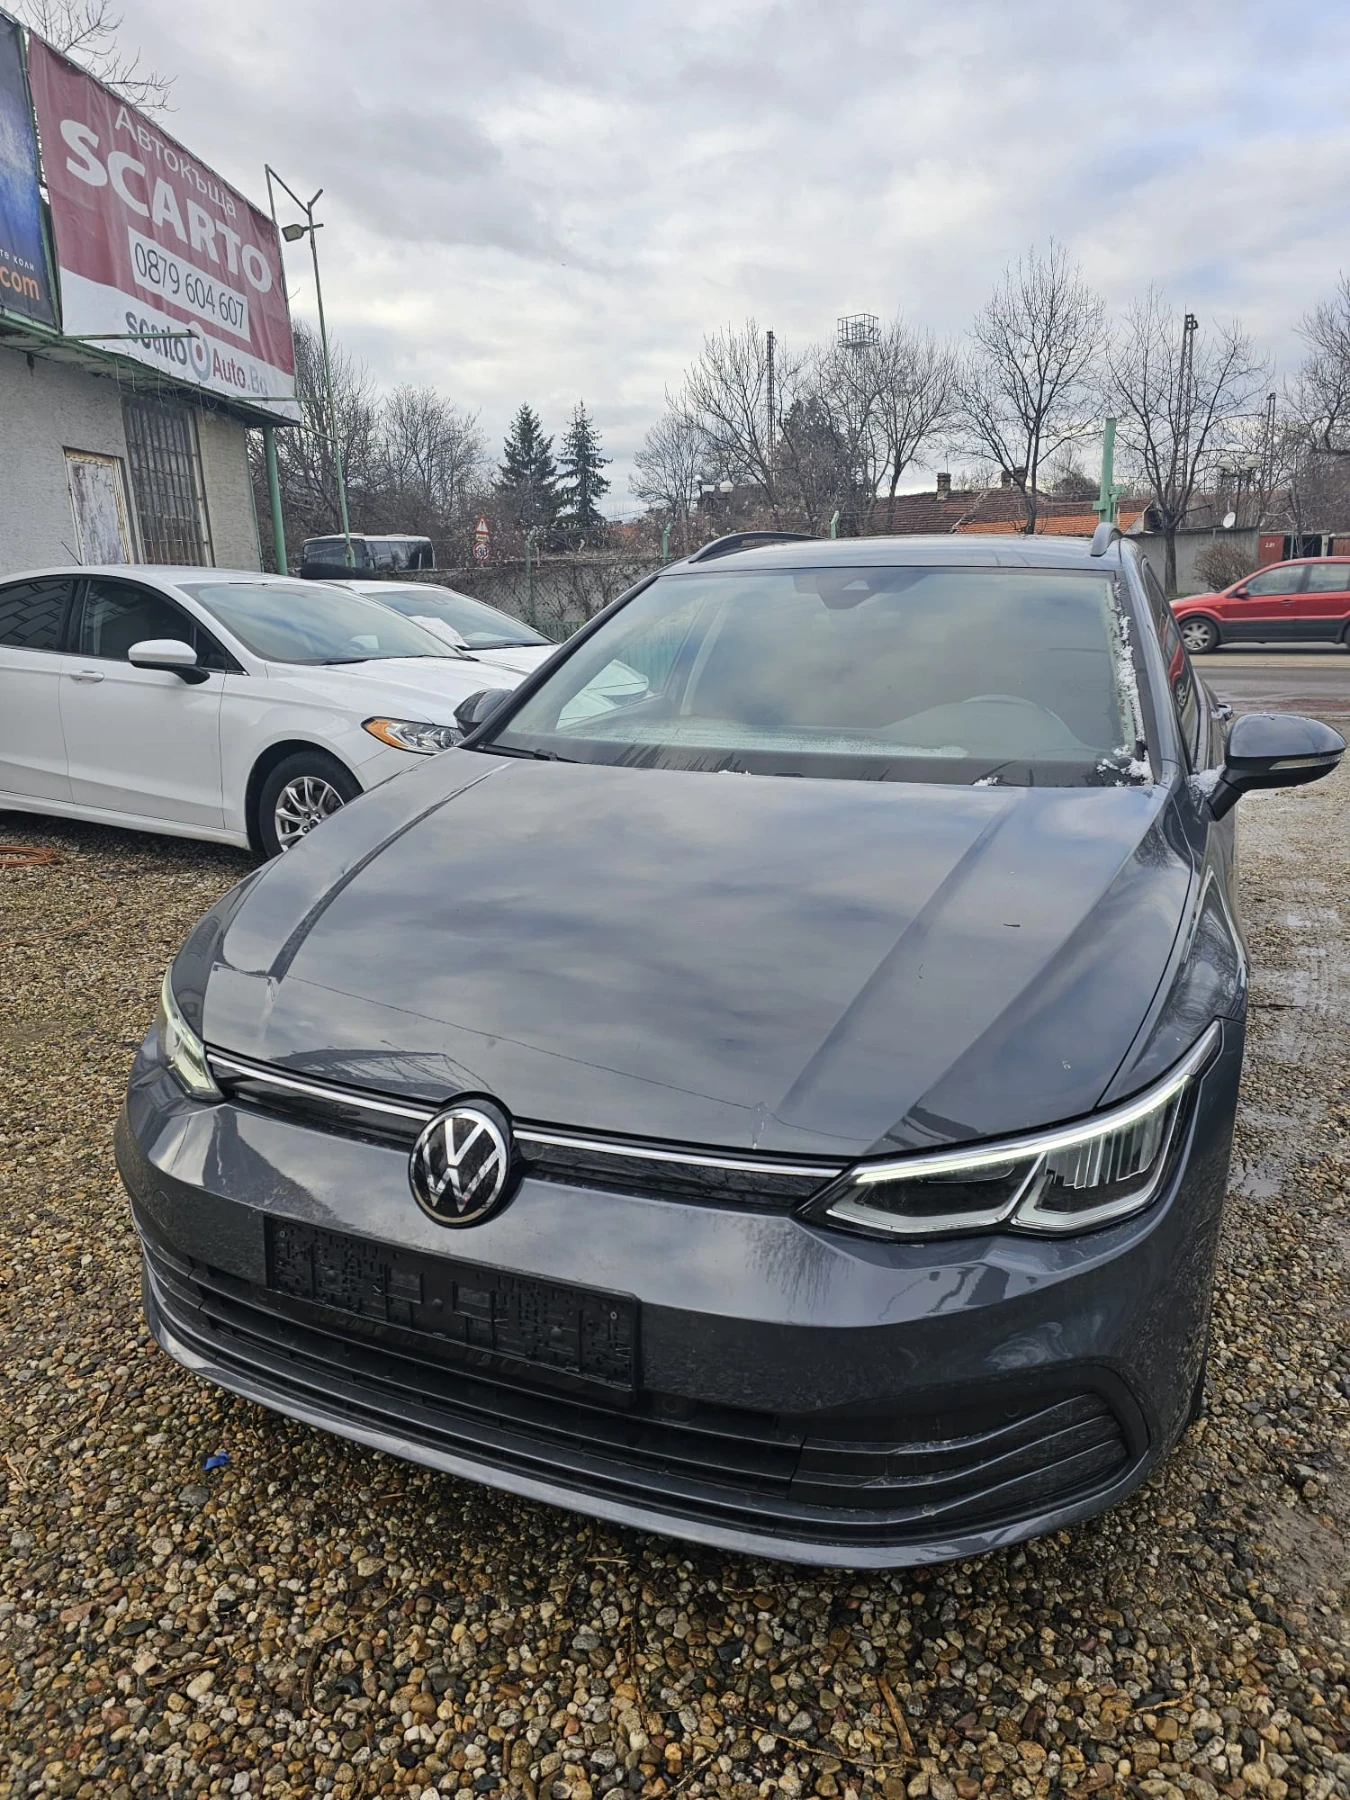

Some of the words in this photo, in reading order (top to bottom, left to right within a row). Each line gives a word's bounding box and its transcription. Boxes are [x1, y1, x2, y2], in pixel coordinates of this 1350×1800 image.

[59, 118, 273, 294] SCARTO
[114, 105, 237, 219] Автокъща
[134, 241, 181, 295] 0879
[185, 272, 216, 315] 604
[219, 291, 244, 330] 607
